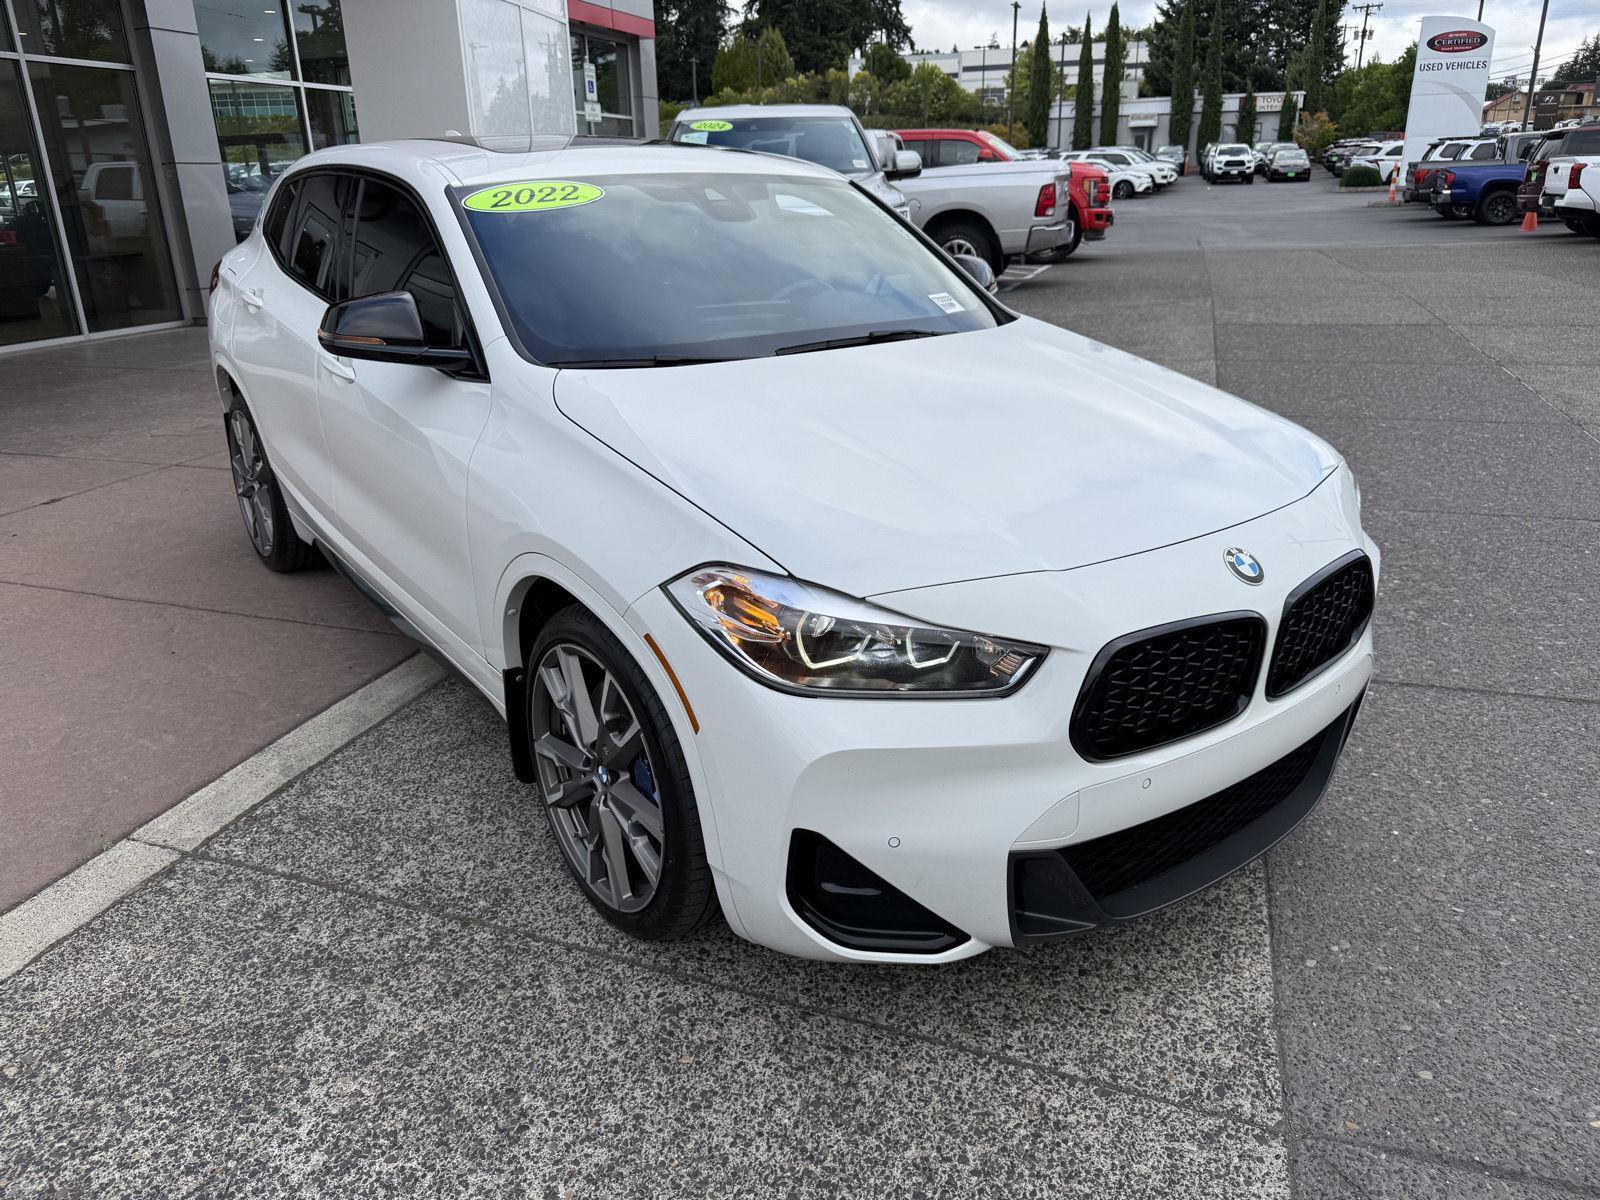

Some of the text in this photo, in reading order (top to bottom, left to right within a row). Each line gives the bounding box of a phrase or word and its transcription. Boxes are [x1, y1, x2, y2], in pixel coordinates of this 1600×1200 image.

[1434, 37, 1480, 46] CERTIFIED
[1419, 60, 1488, 72] USED VEHICLES
[490, 185, 580, 209] 2022
